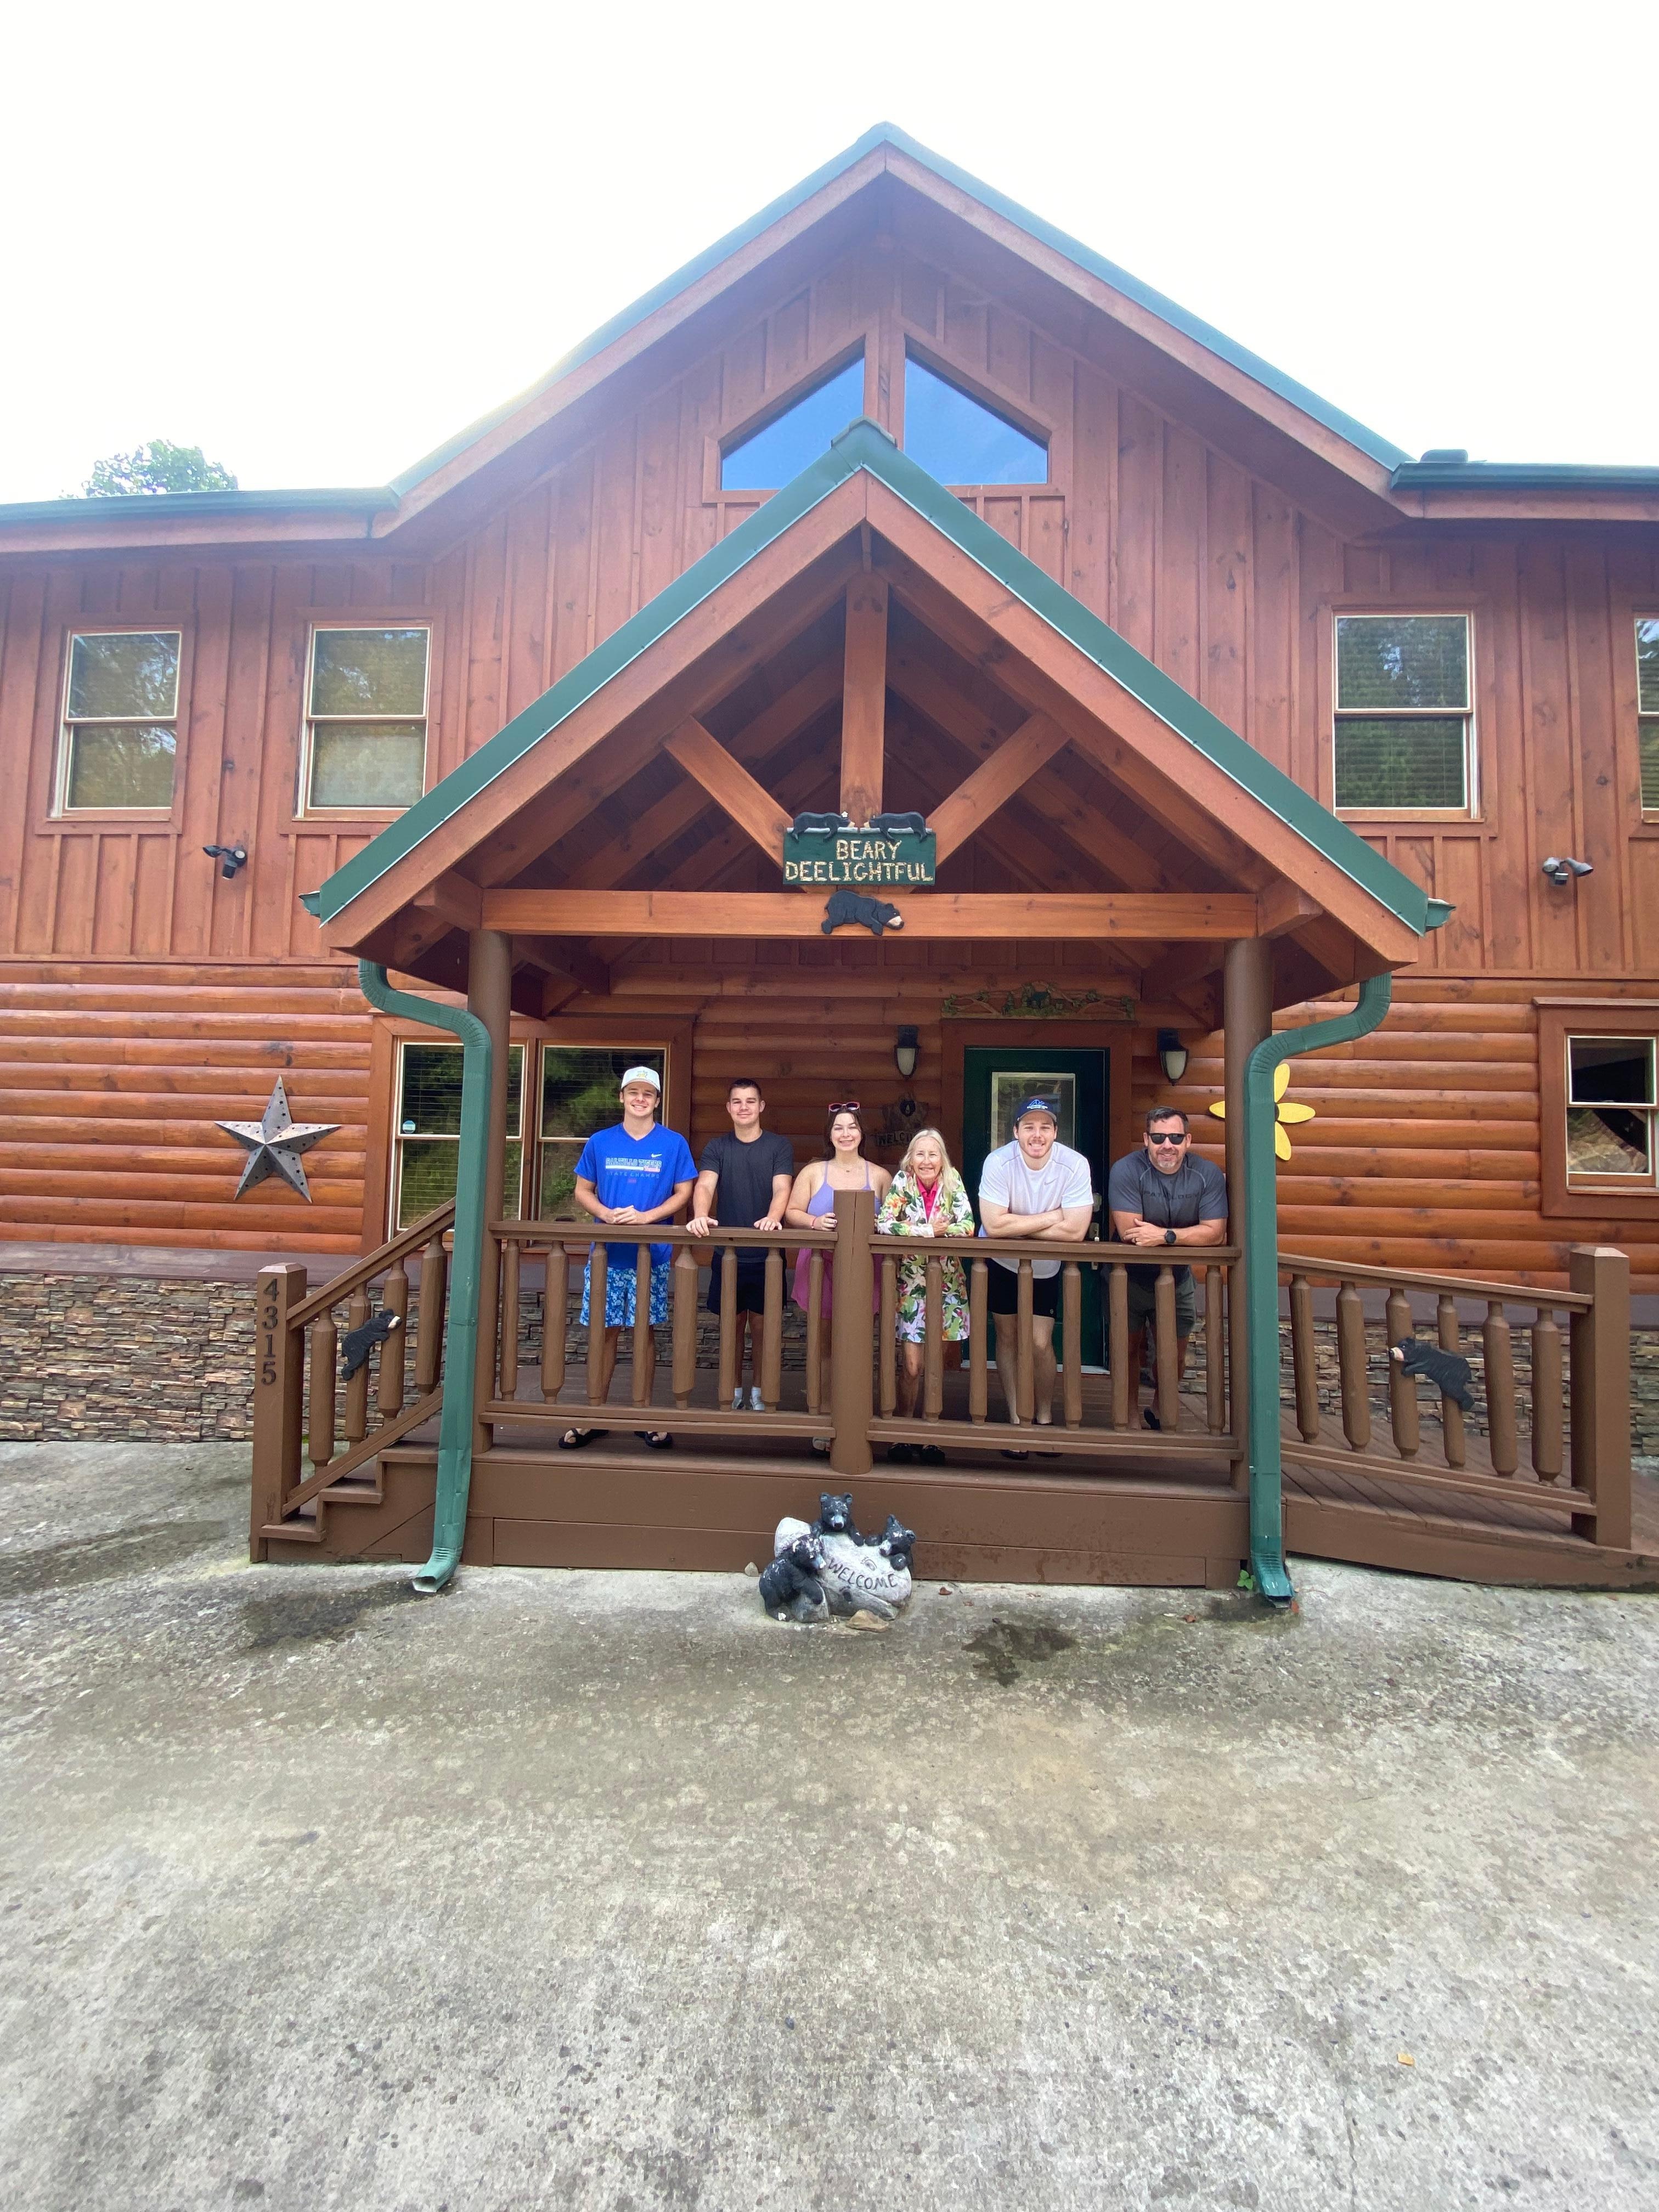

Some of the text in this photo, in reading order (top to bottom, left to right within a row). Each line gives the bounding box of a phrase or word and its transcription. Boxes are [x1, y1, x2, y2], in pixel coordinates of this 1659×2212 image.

[836, 839, 902, 860] BEARY
[785, 860, 934, 882] DEELIGHTFUL
[878, 1131, 913, 1146] WELCO
[638, 1159, 662, 1168] TIGERS
[261, 1278, 279, 1386] 4315
[828, 1558, 898, 1589] WELCOME
